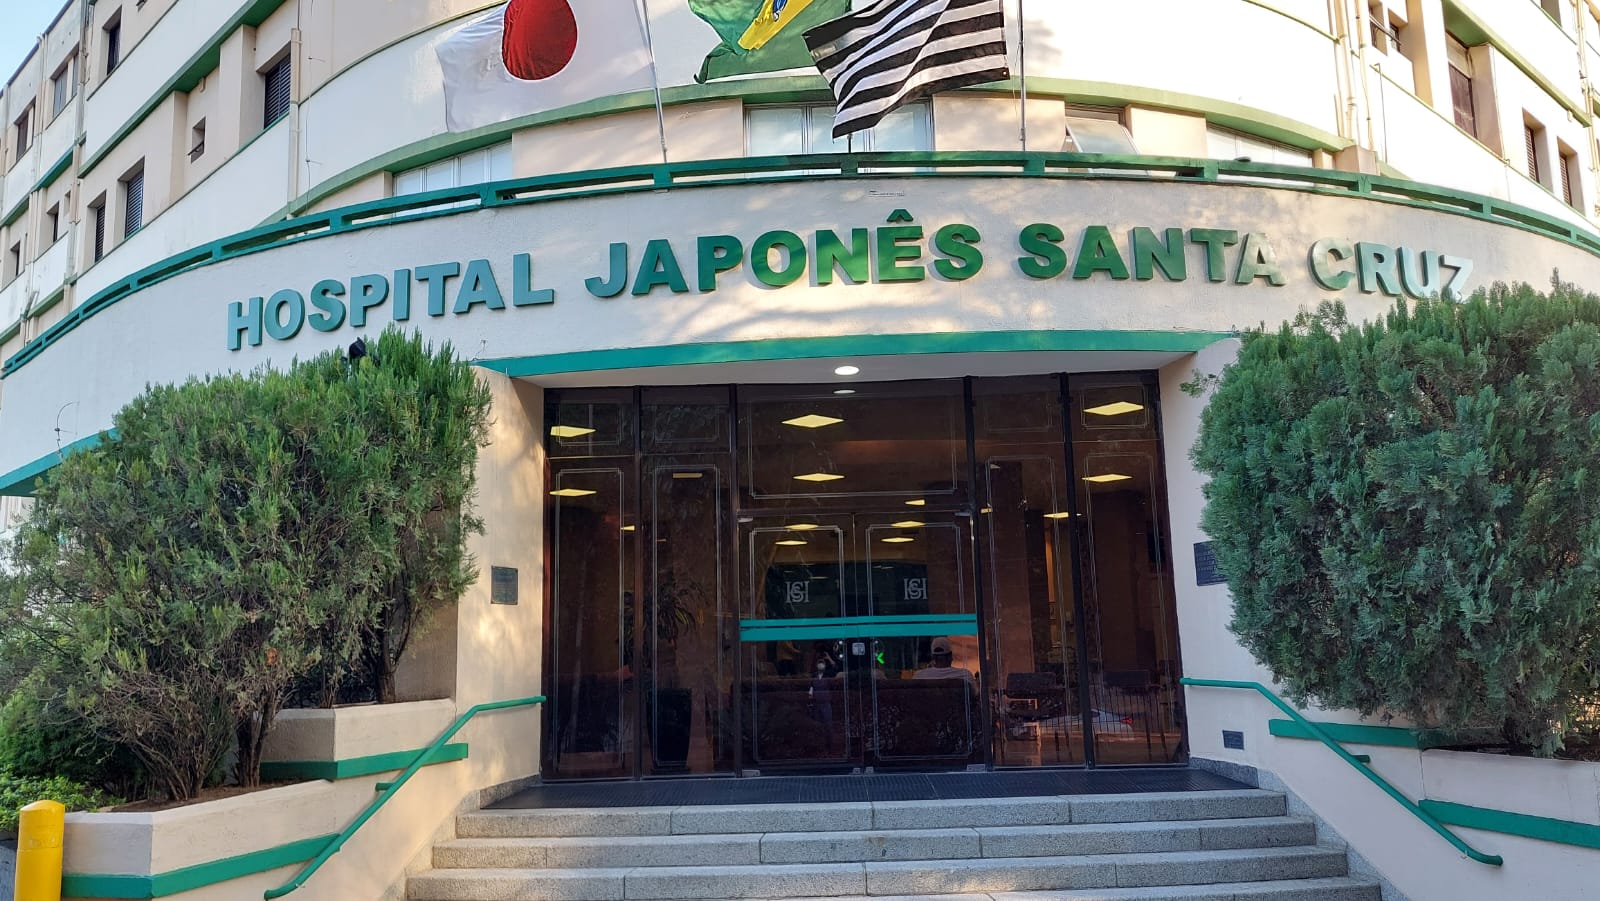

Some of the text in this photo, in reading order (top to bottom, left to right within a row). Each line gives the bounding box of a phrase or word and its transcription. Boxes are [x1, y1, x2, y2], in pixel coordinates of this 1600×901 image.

[228, 208, 1473, 350] HOSPITAL JAPONÊS SANTA CRUZ
